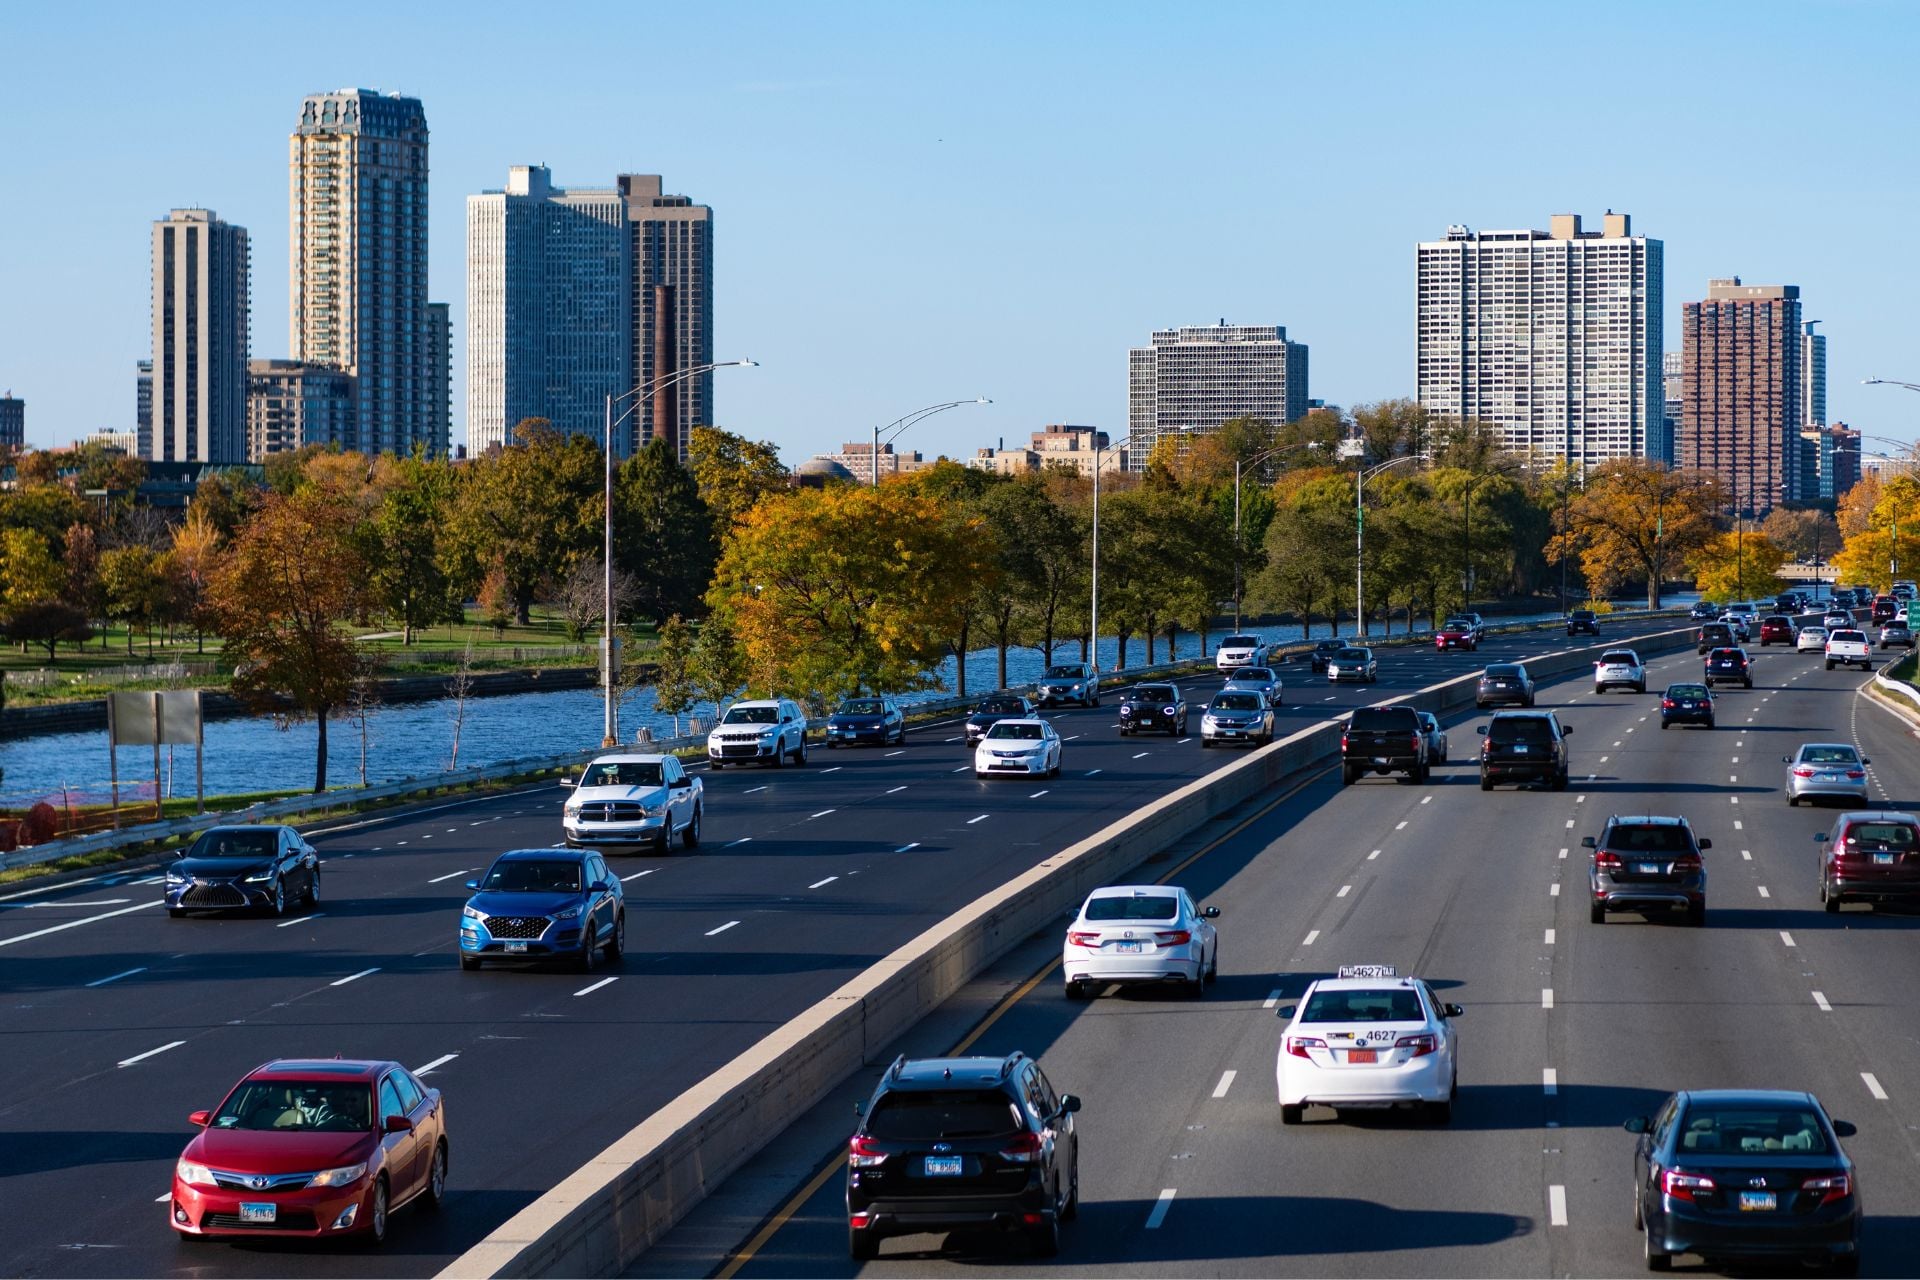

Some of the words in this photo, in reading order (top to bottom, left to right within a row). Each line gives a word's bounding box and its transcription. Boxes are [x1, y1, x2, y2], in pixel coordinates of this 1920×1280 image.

[1342, 967, 1354, 977] TAXI
[1354, 967, 1381, 977] 4627
[1383, 967, 1395, 977] TAXI
[1366, 1030, 1397, 1041] 4627
